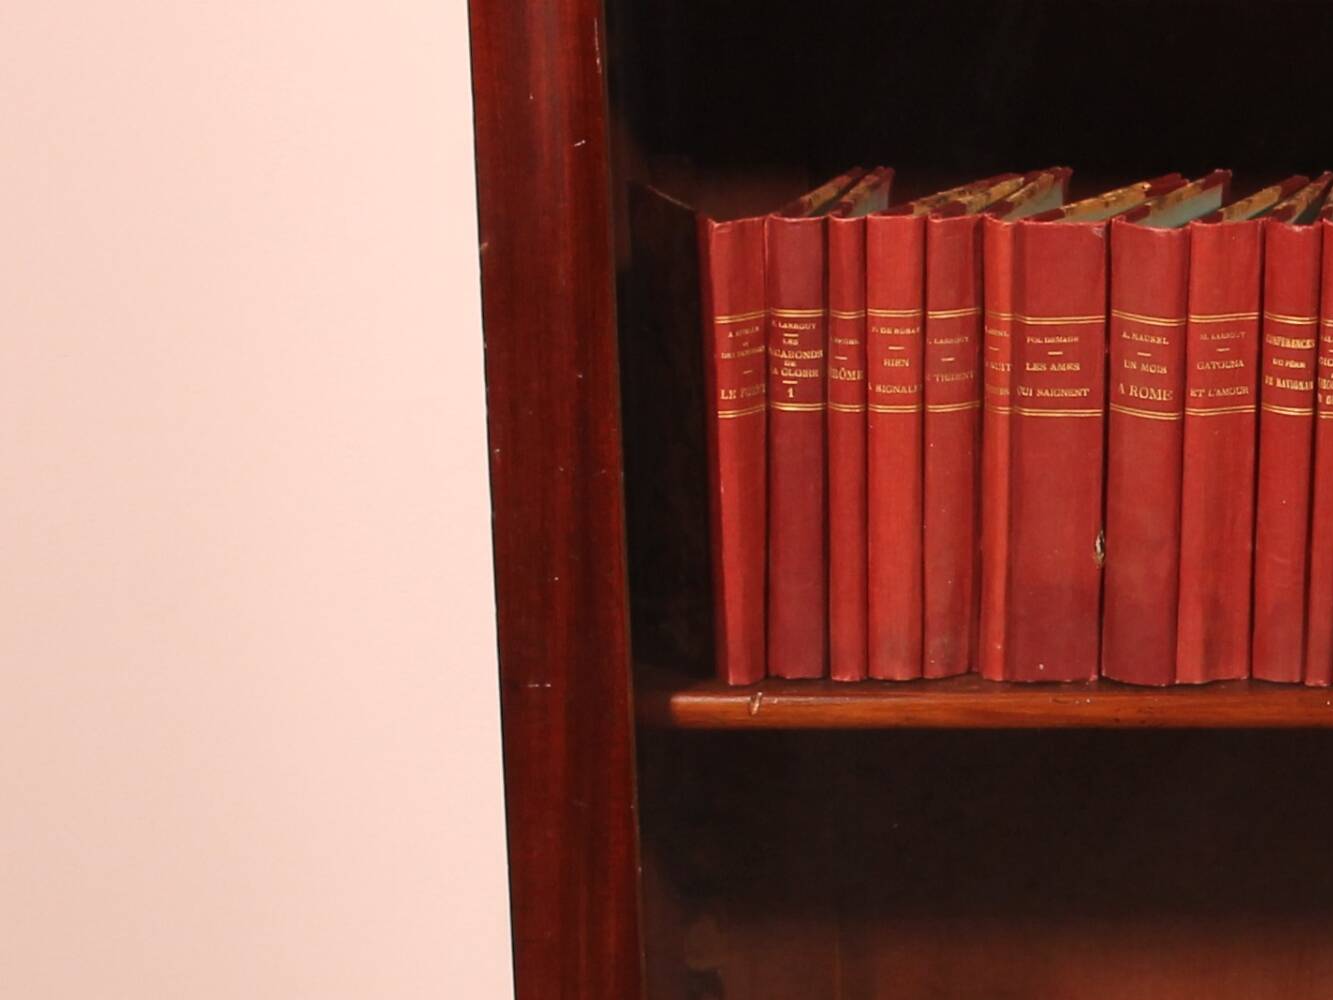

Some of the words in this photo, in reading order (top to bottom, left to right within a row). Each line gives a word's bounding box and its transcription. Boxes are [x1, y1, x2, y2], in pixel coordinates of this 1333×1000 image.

[1025, 362, 1048, 372] LES
[1049, 362, 1082, 372] AMES
[1123, 359, 1138, 370] UN
[1139, 362, 1168, 375] MOIS
[787, 387, 795, 398] 1
[1035, 386, 1091, 398] SAIGNENT
[1128, 383, 1174, 401] ROME
[1189, 387, 1205, 398] ET
